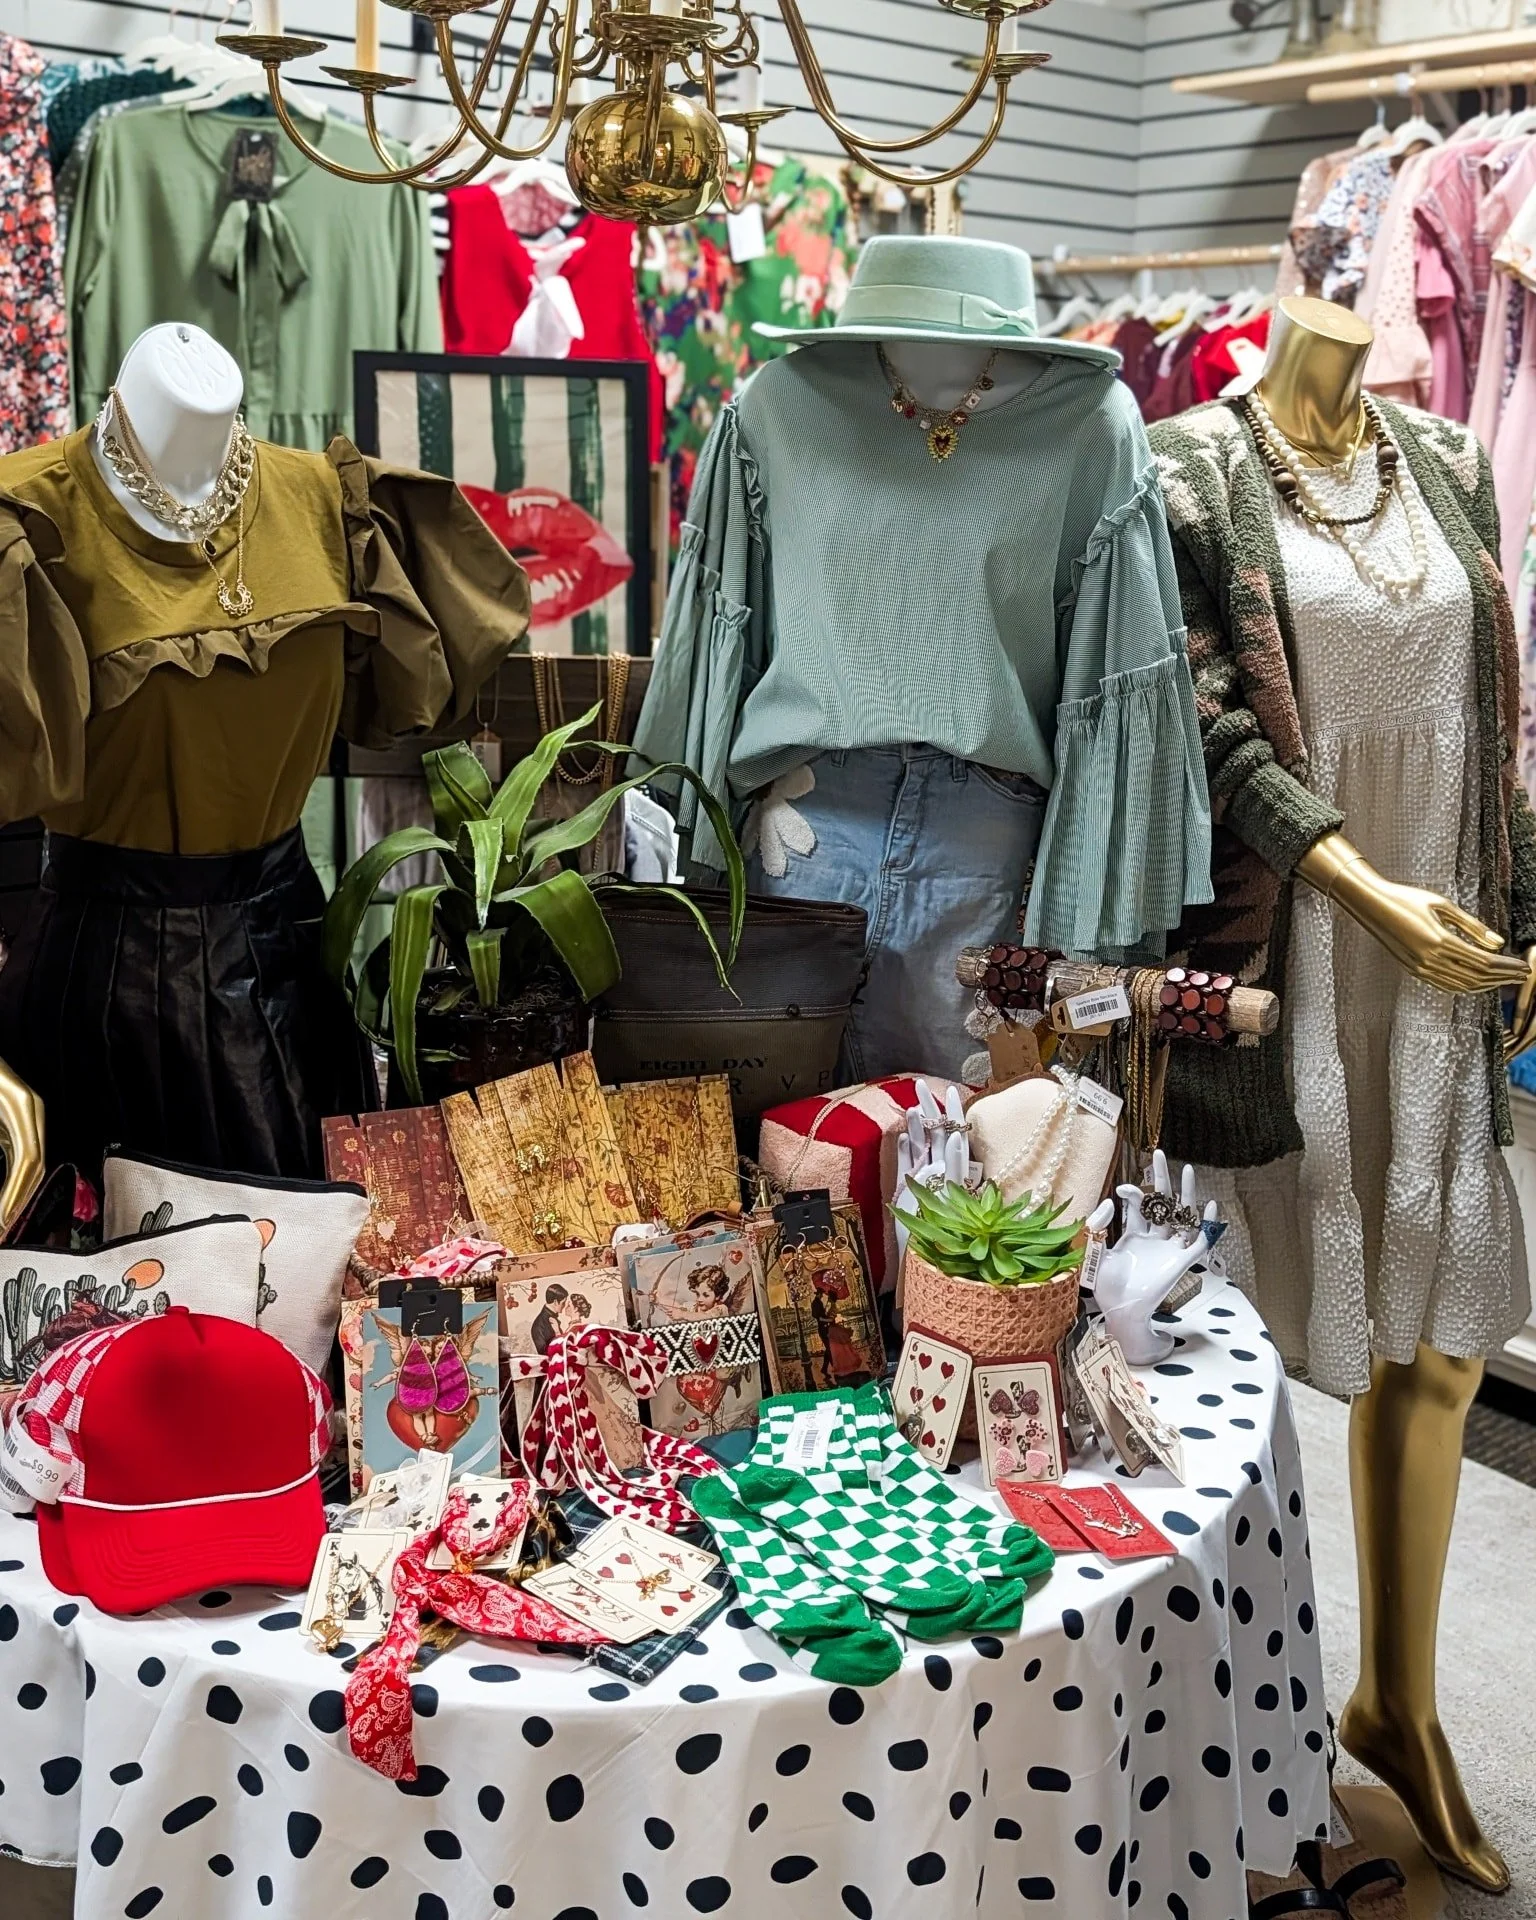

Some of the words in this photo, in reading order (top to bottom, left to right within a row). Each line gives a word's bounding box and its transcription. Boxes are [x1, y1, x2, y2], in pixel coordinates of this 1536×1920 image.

[723, 1057, 768, 1070] DAY
[781, 1074, 797, 1091] V
[912, 1341, 919, 1352] 6
[981, 1377, 989, 1389] 2
[936, 1448, 943, 1459] 6
[1047, 1464, 1055, 1477] 2
[330, 1541, 340, 1551] K
[582, 1572, 592, 1580] 5
[379, 1621, 390, 1632] K
